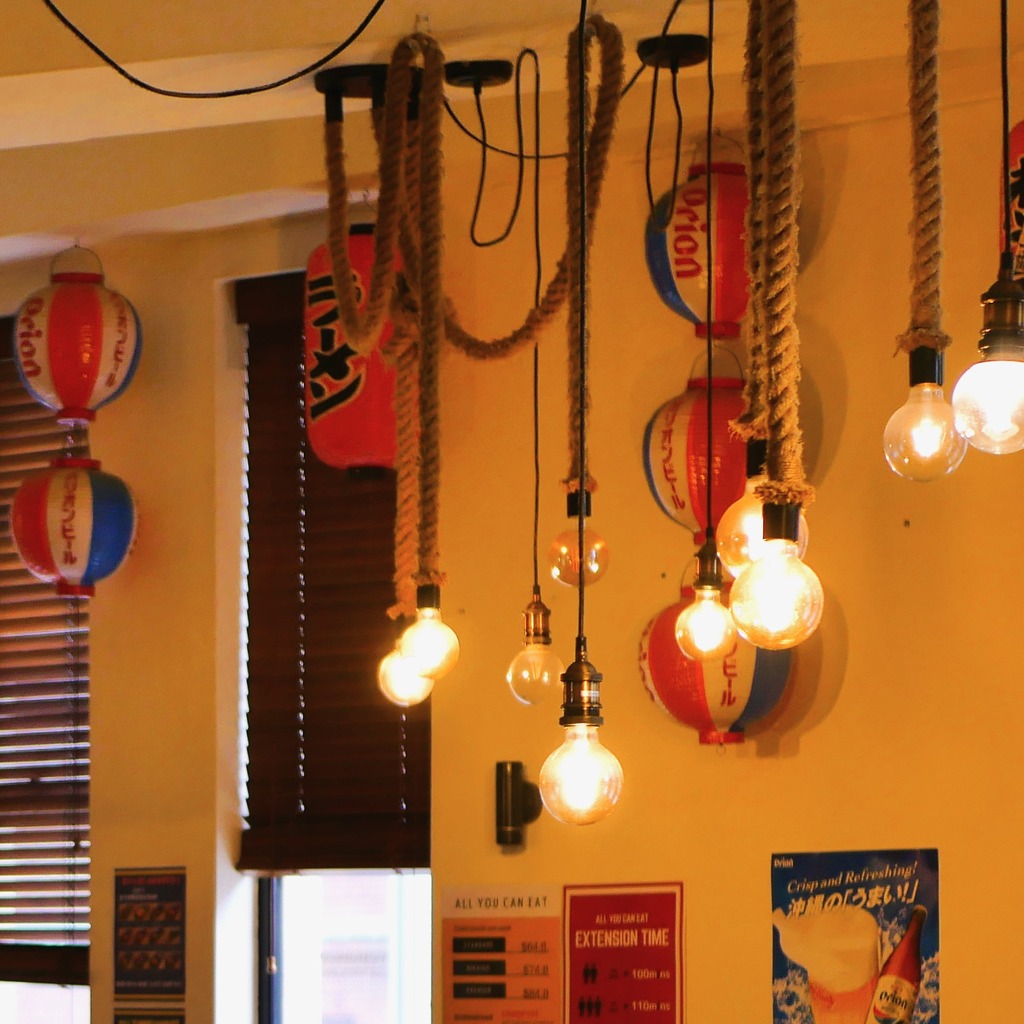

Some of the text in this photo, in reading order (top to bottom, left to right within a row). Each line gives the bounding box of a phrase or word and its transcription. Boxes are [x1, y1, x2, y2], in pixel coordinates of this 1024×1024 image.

[20, 297, 43, 377] Orion
[787, 878, 819, 893] Crisp
[820, 872, 843, 889] and
[456, 898, 472, 909] ALL
[478, 897, 499, 908] YOU
[503, 896, 524, 907] CAN
[575, 928, 670, 948] EXTENSION TIME
